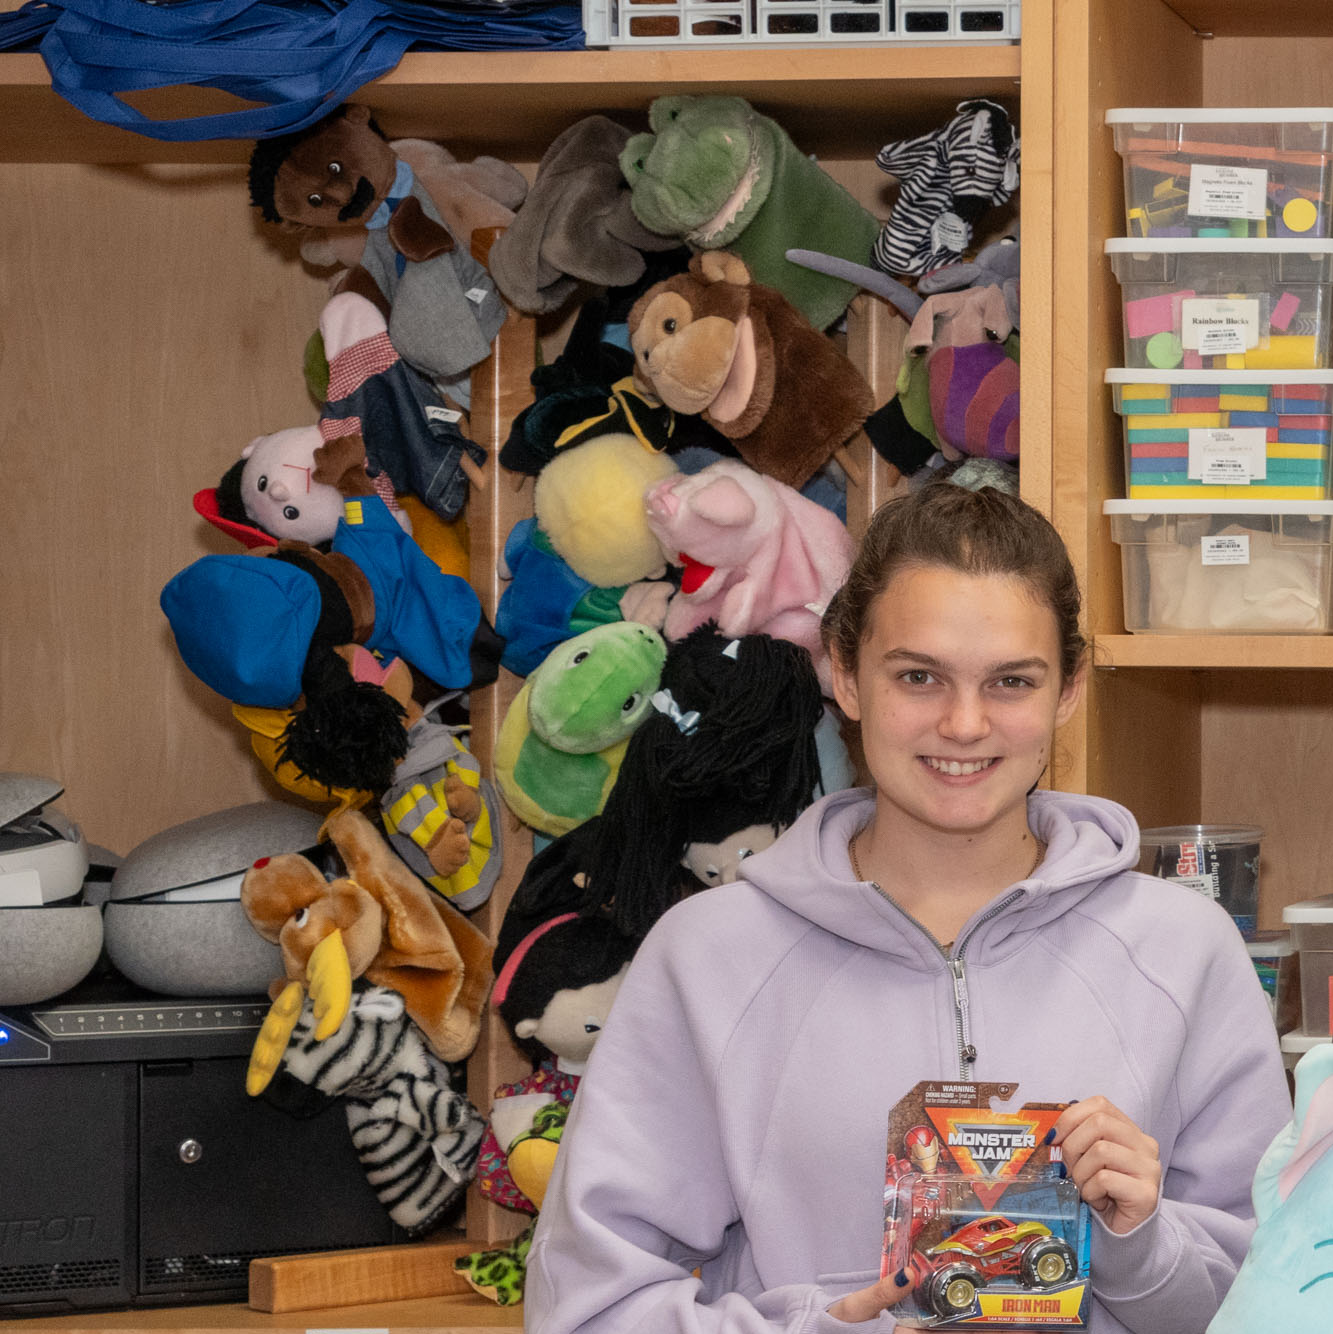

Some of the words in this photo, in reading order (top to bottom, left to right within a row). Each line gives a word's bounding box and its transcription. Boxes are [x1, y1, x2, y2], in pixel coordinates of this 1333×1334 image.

[1192, 317, 1223, 325] Rainbow
[1226, 317, 1249, 325] Blocks
[942, 1084, 976, 1093] WARNING:
[948, 1132, 1036, 1148] MONSTER
[972, 1147, 1012, 1161] JAM
[1002, 1298, 1032, 1312] IRON
[1034, 1300, 1060, 1313] MAN
